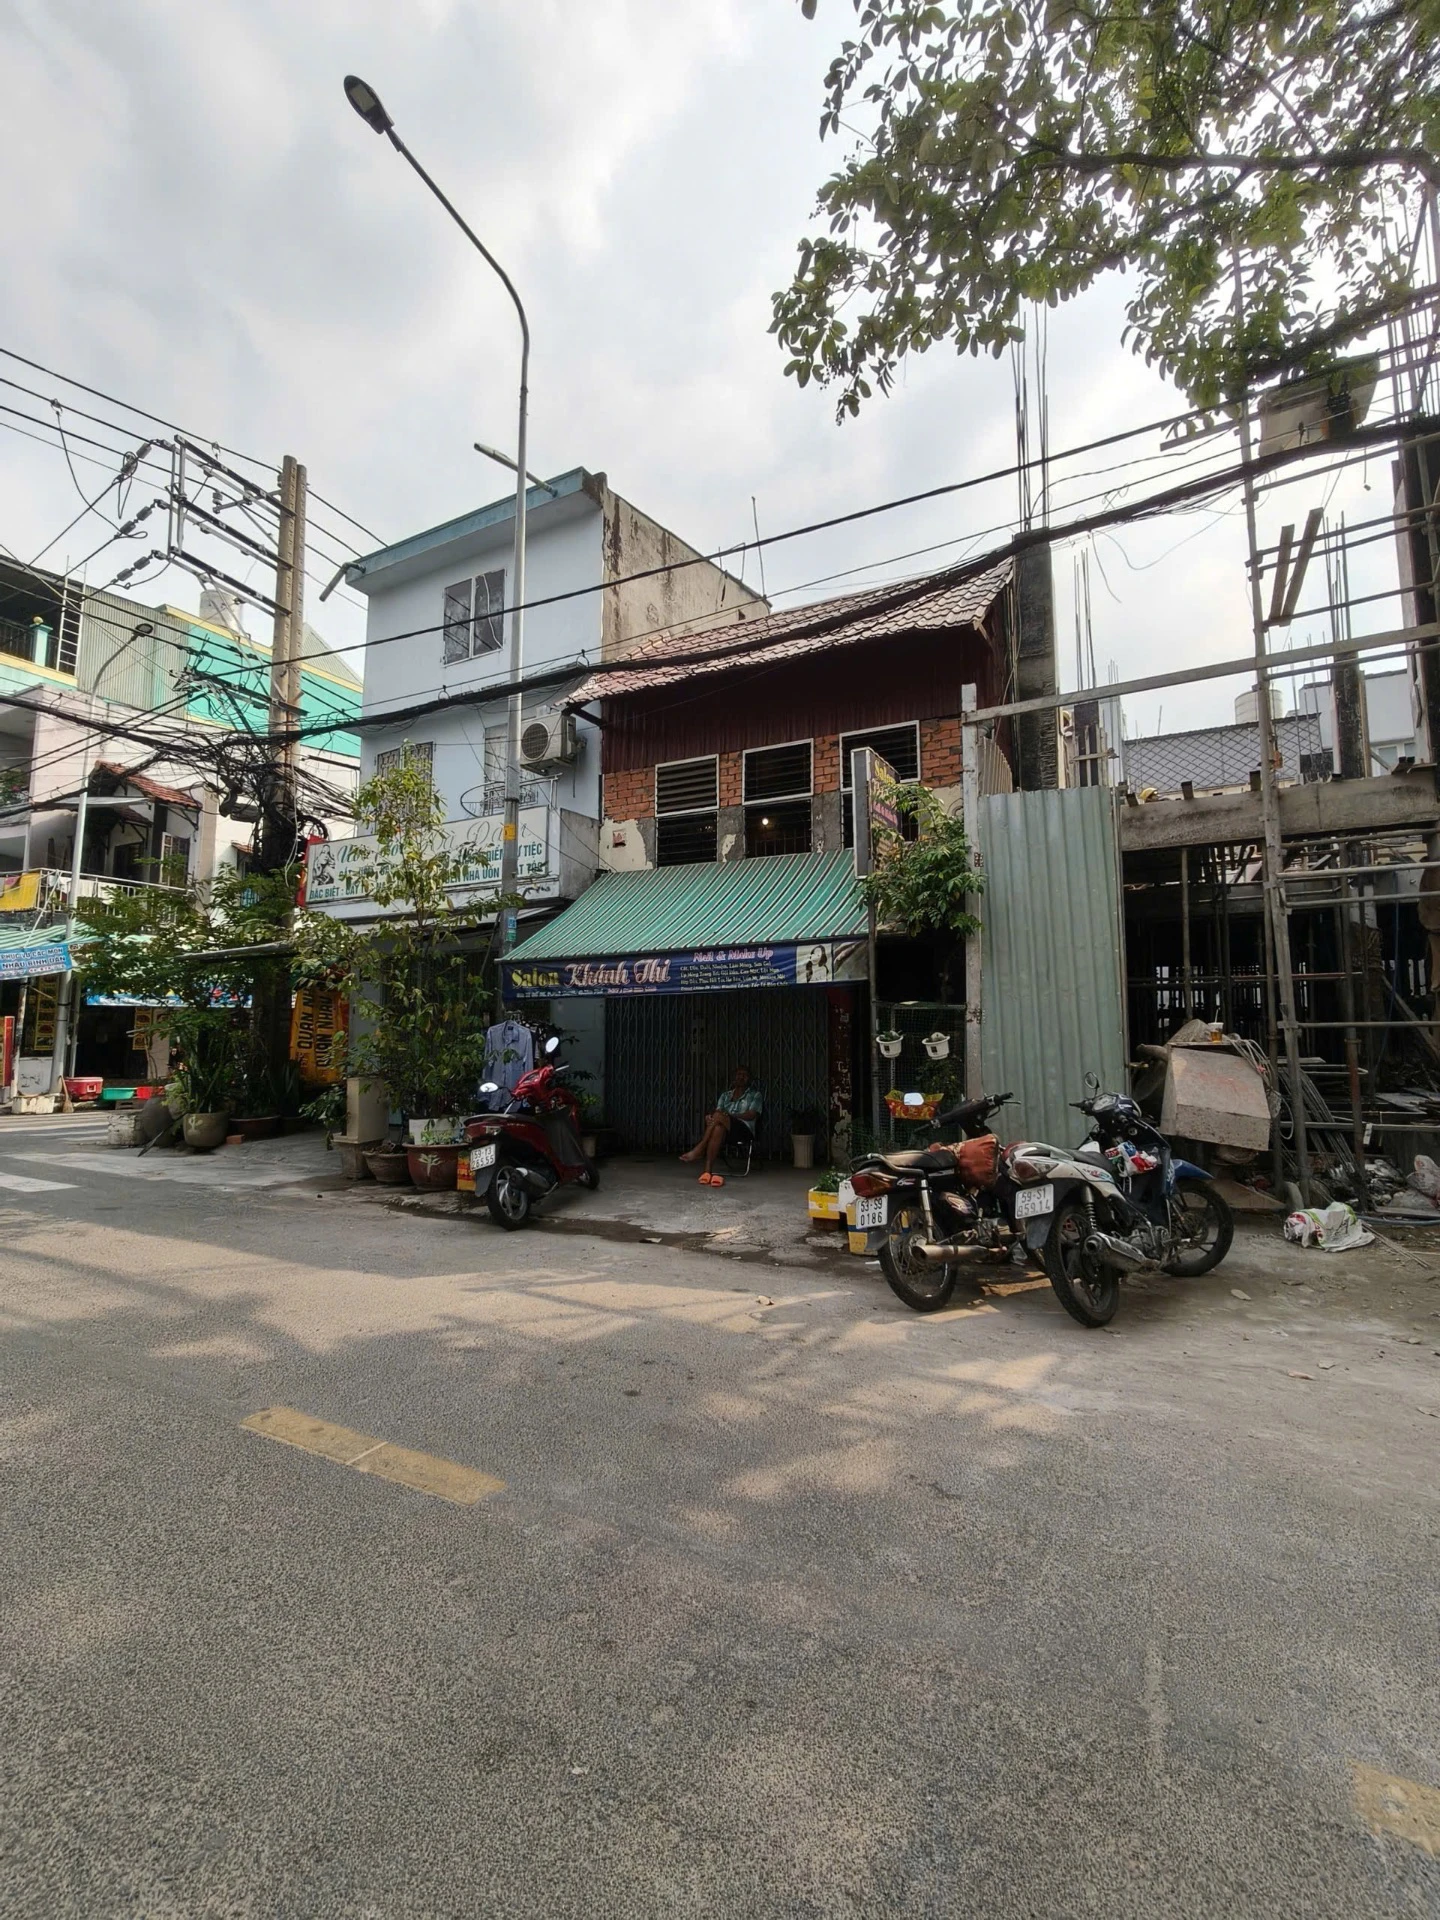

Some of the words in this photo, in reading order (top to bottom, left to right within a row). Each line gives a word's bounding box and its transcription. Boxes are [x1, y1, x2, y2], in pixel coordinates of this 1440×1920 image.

[523, 841, 542, 858] TIỆC
[693, 952, 714, 963] Nail
[716, 950, 727, 961] &
[728, 949, 756, 961] Make
[757, 947, 774, 960] Up
[511, 967, 559, 989] Salon
[564, 961, 631, 988] Khánh
[1021, 1187, 1046, 1204] 59-S1
[861, 1197, 883, 1213] 53-S9
[861, 1211, 883, 1226] 0186
